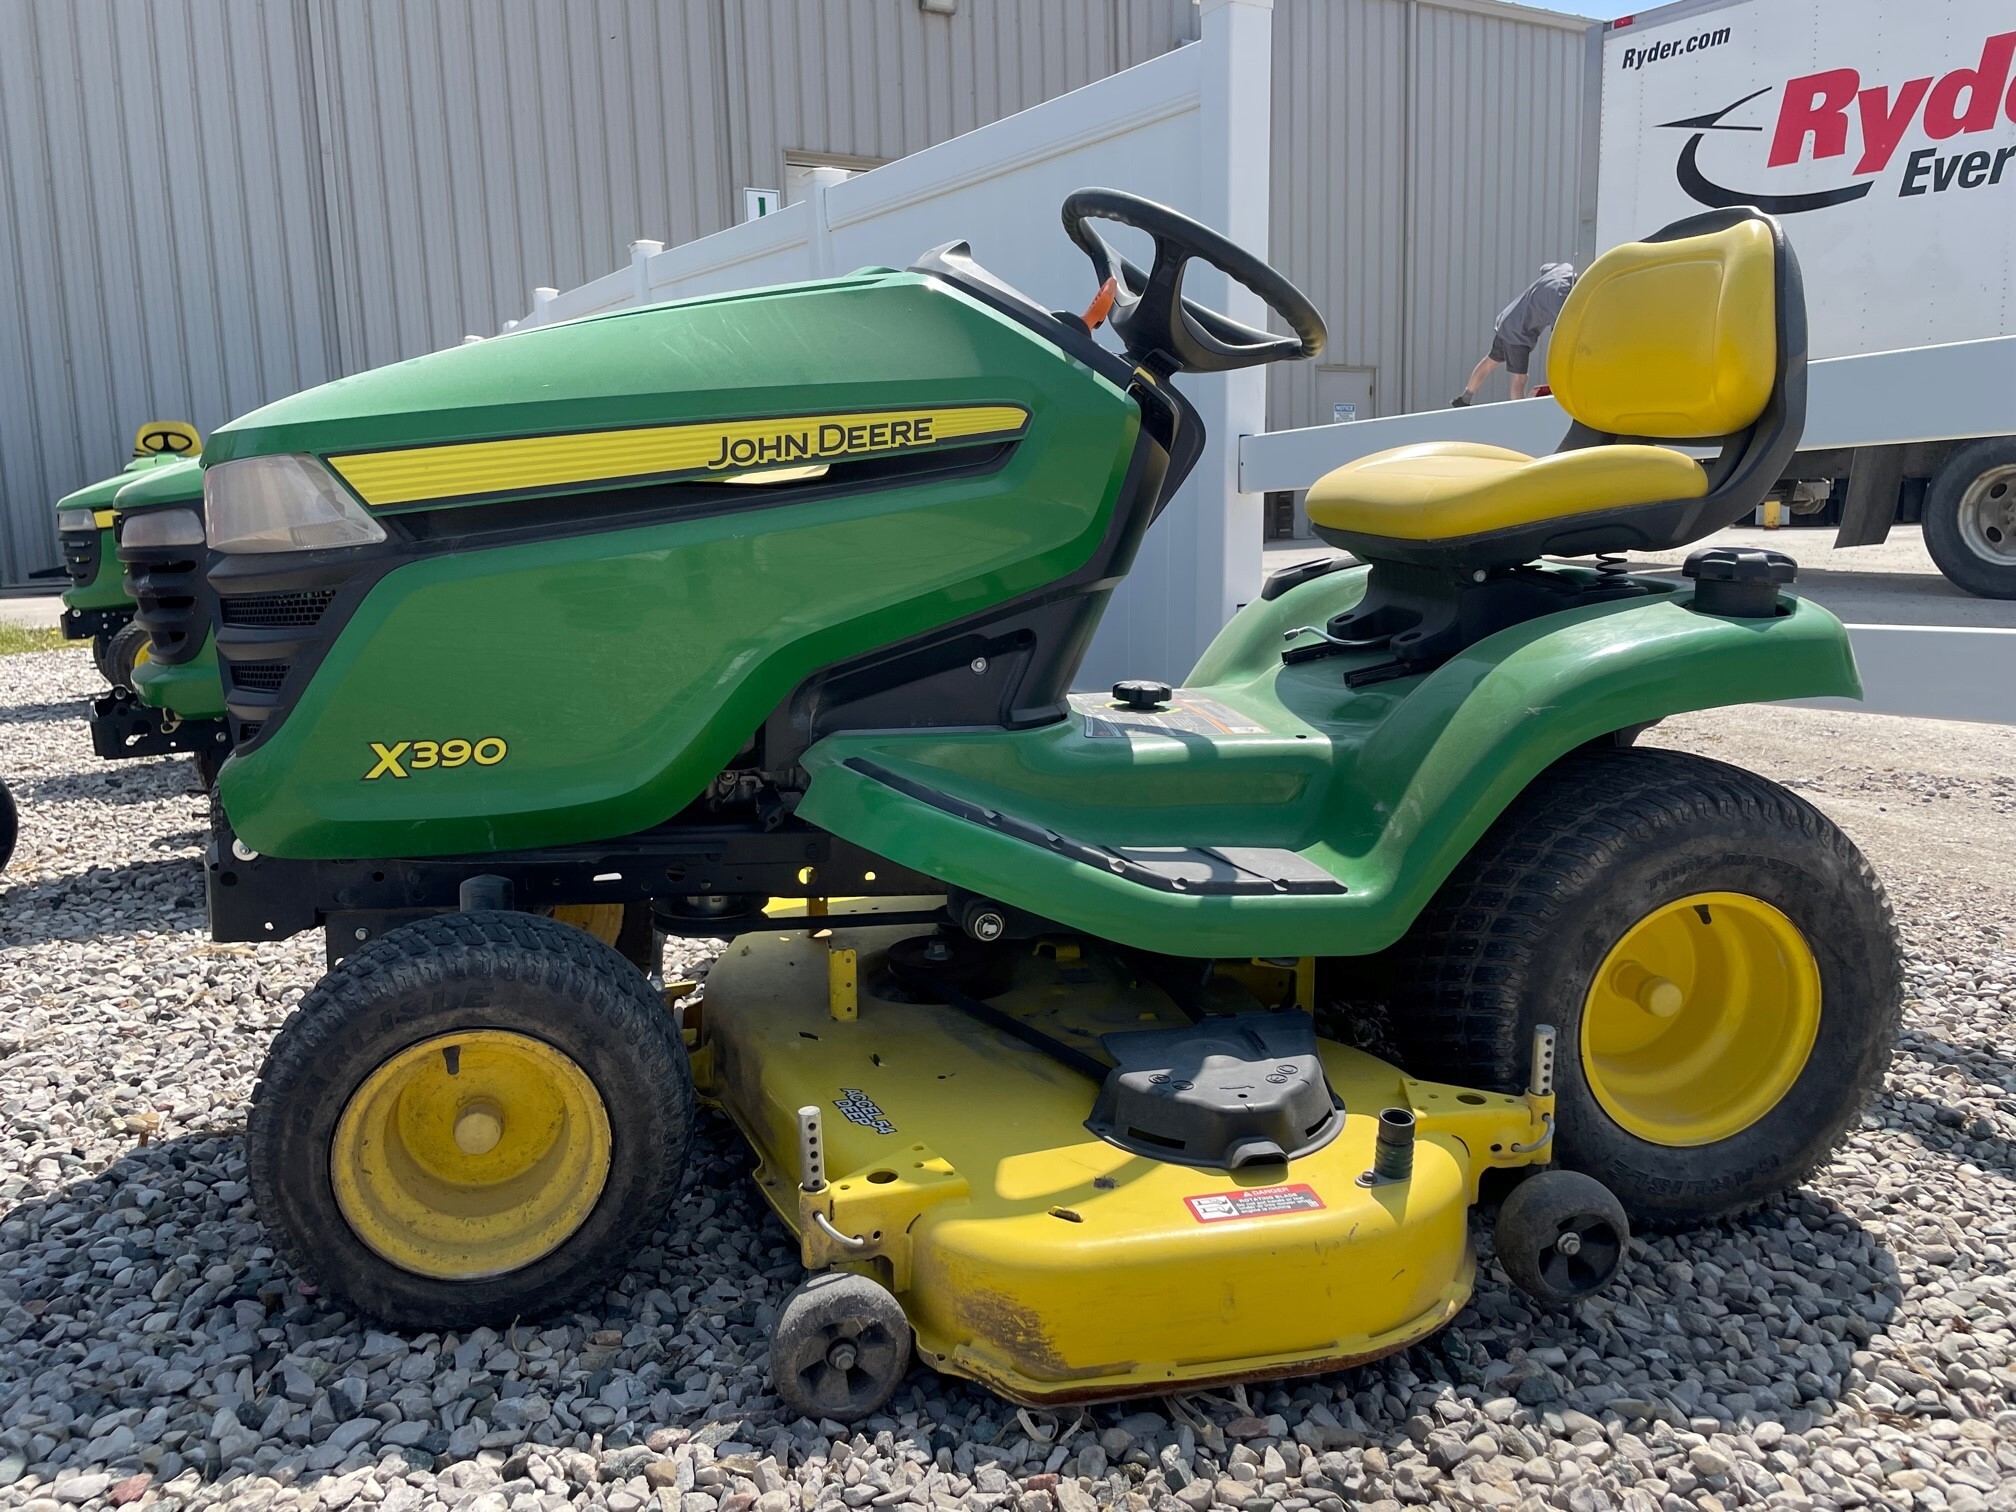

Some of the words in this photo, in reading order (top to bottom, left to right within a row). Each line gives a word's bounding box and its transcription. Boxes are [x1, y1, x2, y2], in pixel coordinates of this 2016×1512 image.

[1622, 27, 1731, 70] Ryder.com
[1767, 30, 2016, 176] Ryd
[1898, 145, 2016, 197] Ever
[708, 432, 809, 467] JOHN
[819, 417, 933, 454] DEERE
[362, 737, 507, 780] X390
[832, 1099, 872, 1126] DEEP
[839, 1088, 884, 1120] ACCEL
[871, 1119, 898, 1134] 54
[1252, 1187, 1289, 1195] DANGER
